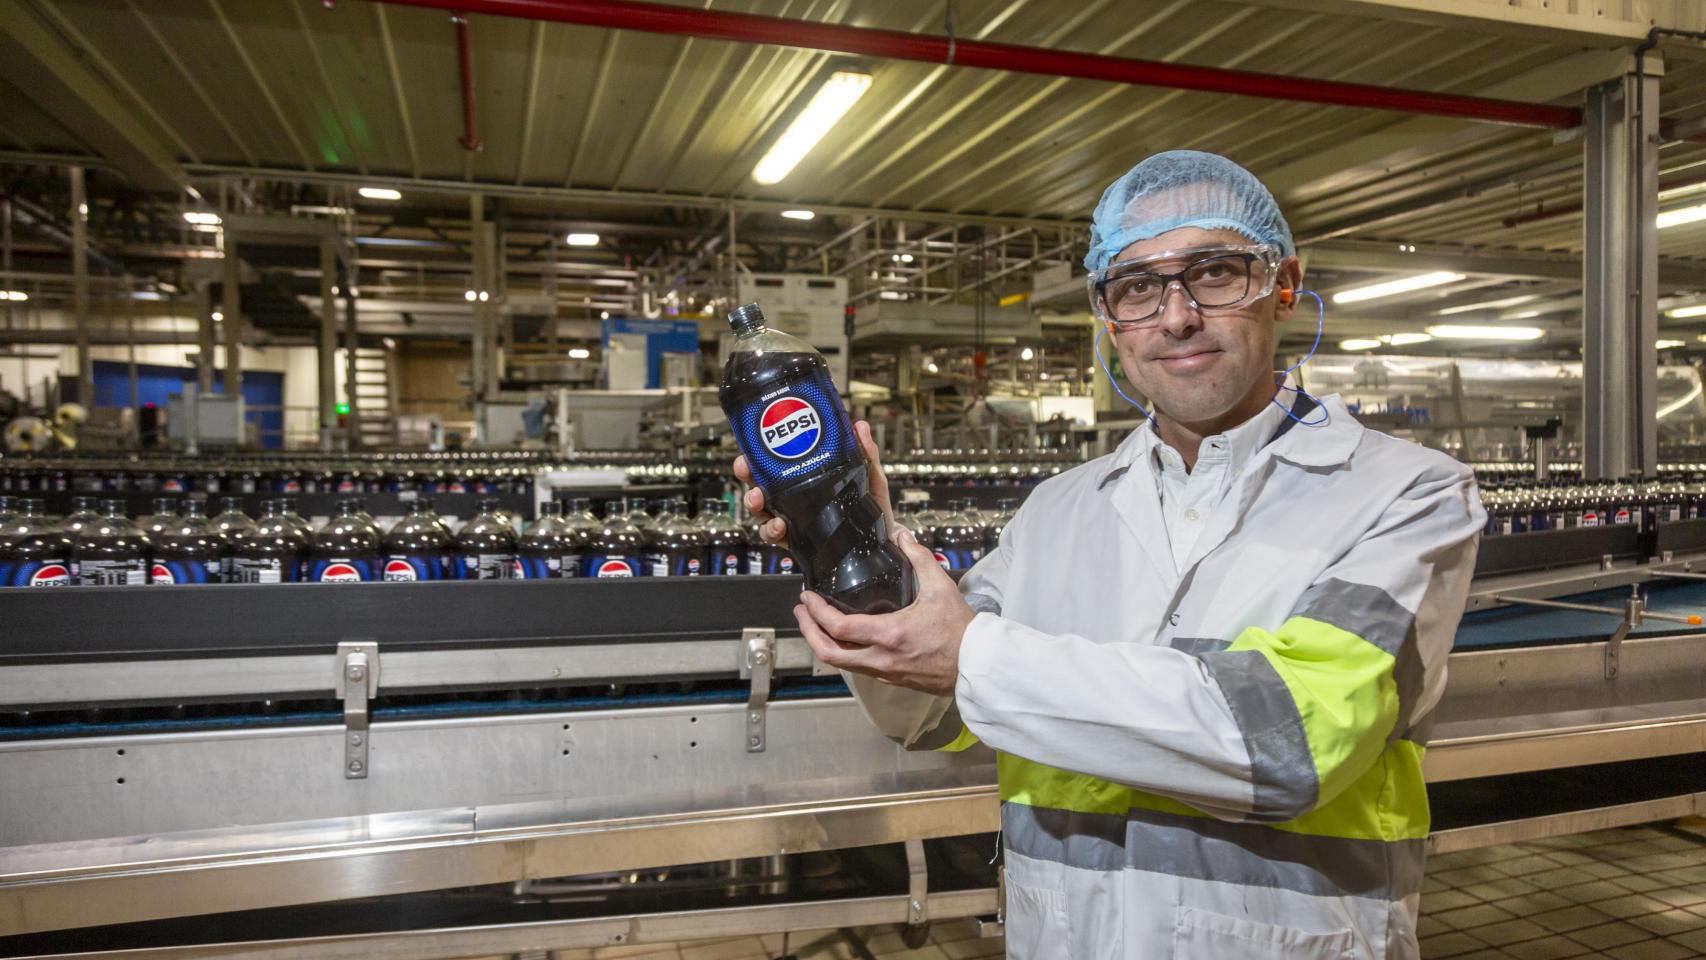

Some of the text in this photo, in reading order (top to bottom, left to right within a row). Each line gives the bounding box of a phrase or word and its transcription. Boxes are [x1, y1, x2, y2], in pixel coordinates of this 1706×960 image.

[765, 413, 816, 443] PEPSI
[782, 452, 830, 476] ZERO AZÚCAR
